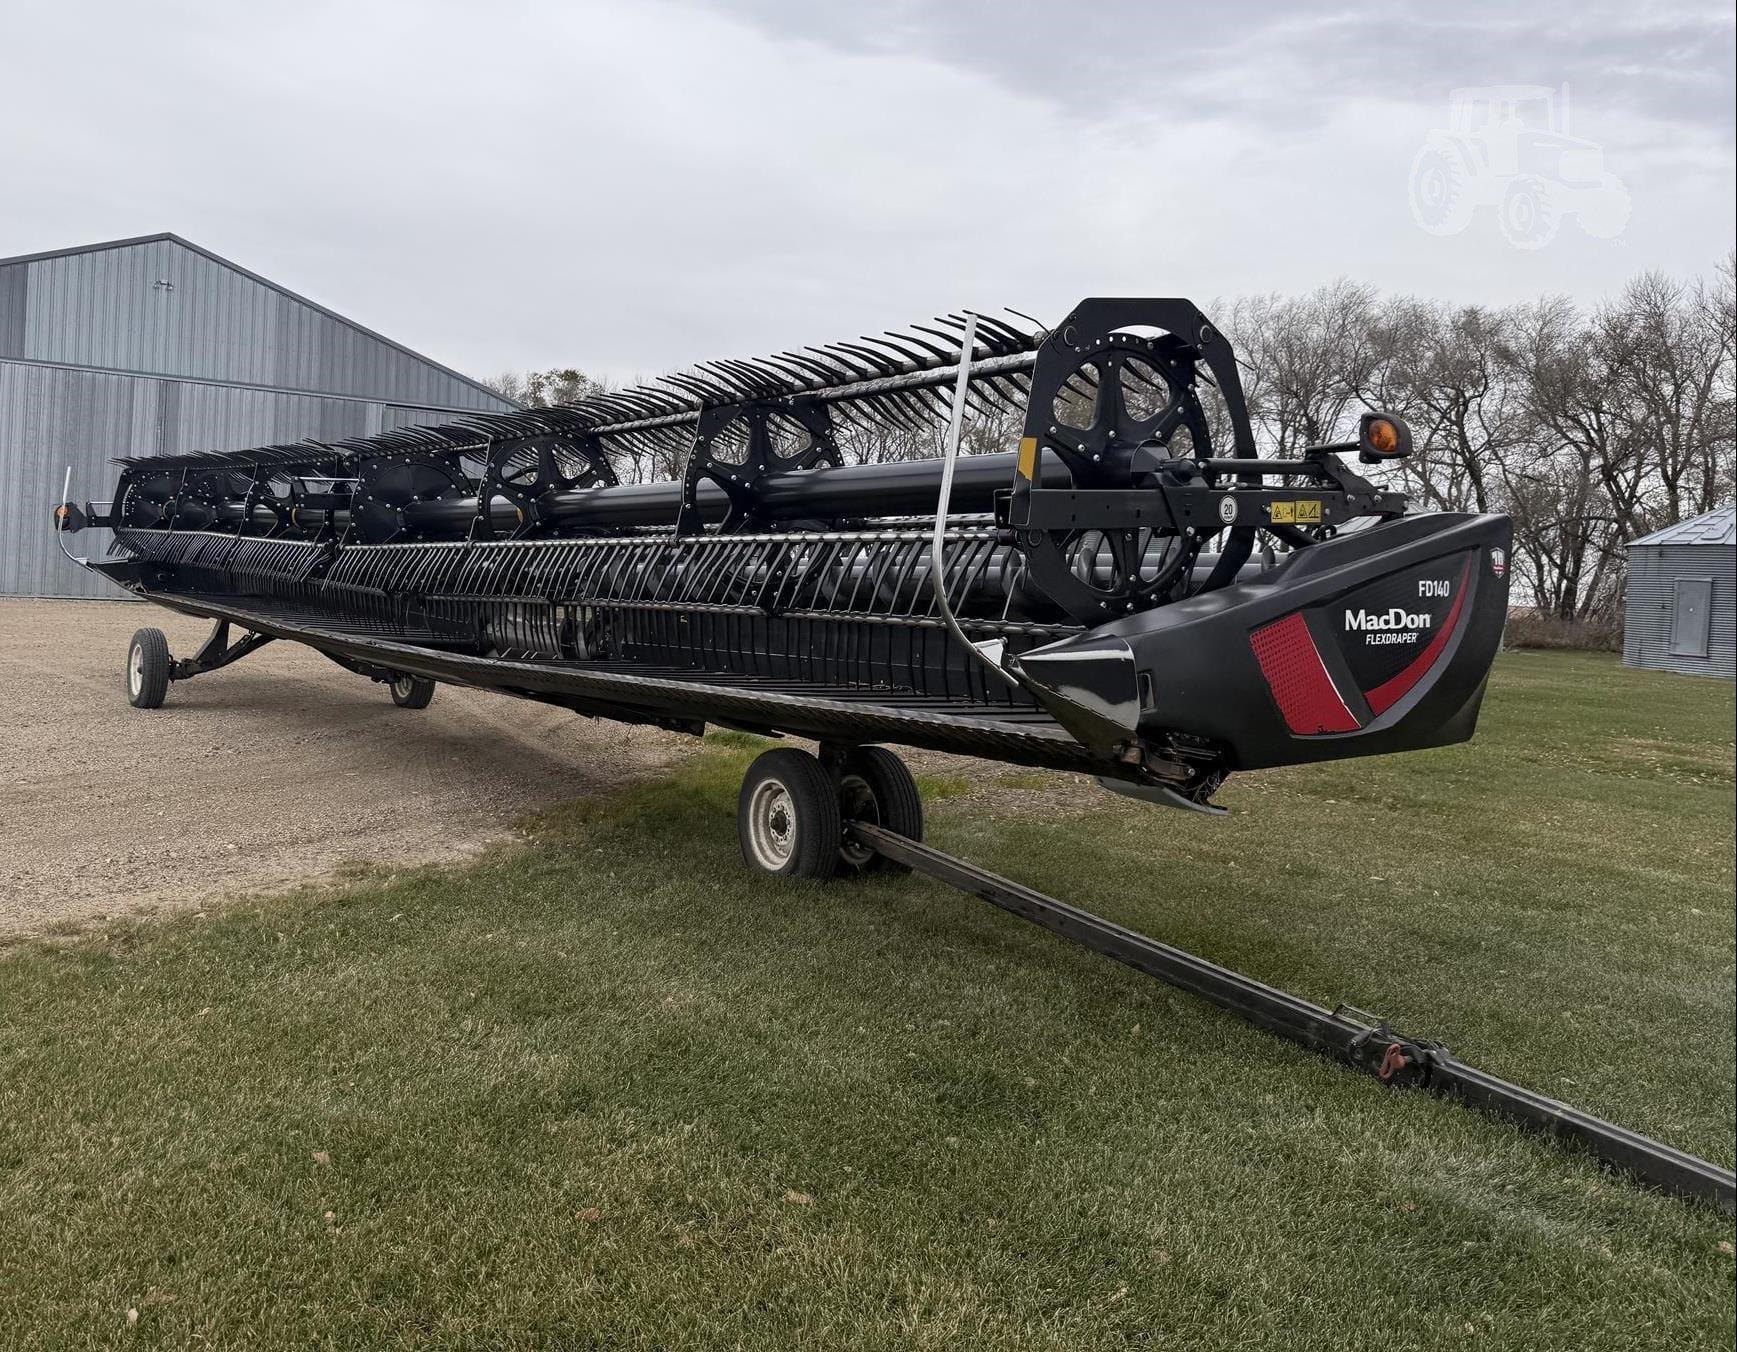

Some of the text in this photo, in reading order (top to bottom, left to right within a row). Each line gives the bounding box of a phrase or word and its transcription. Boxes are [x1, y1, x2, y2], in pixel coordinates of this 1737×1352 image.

[1224, 504, 1233, 515] 20
[1418, 580, 1450, 598] FD140
[1345, 608, 1432, 631] MacDon
[1365, 633, 1419, 645] FLEXDRAPER
